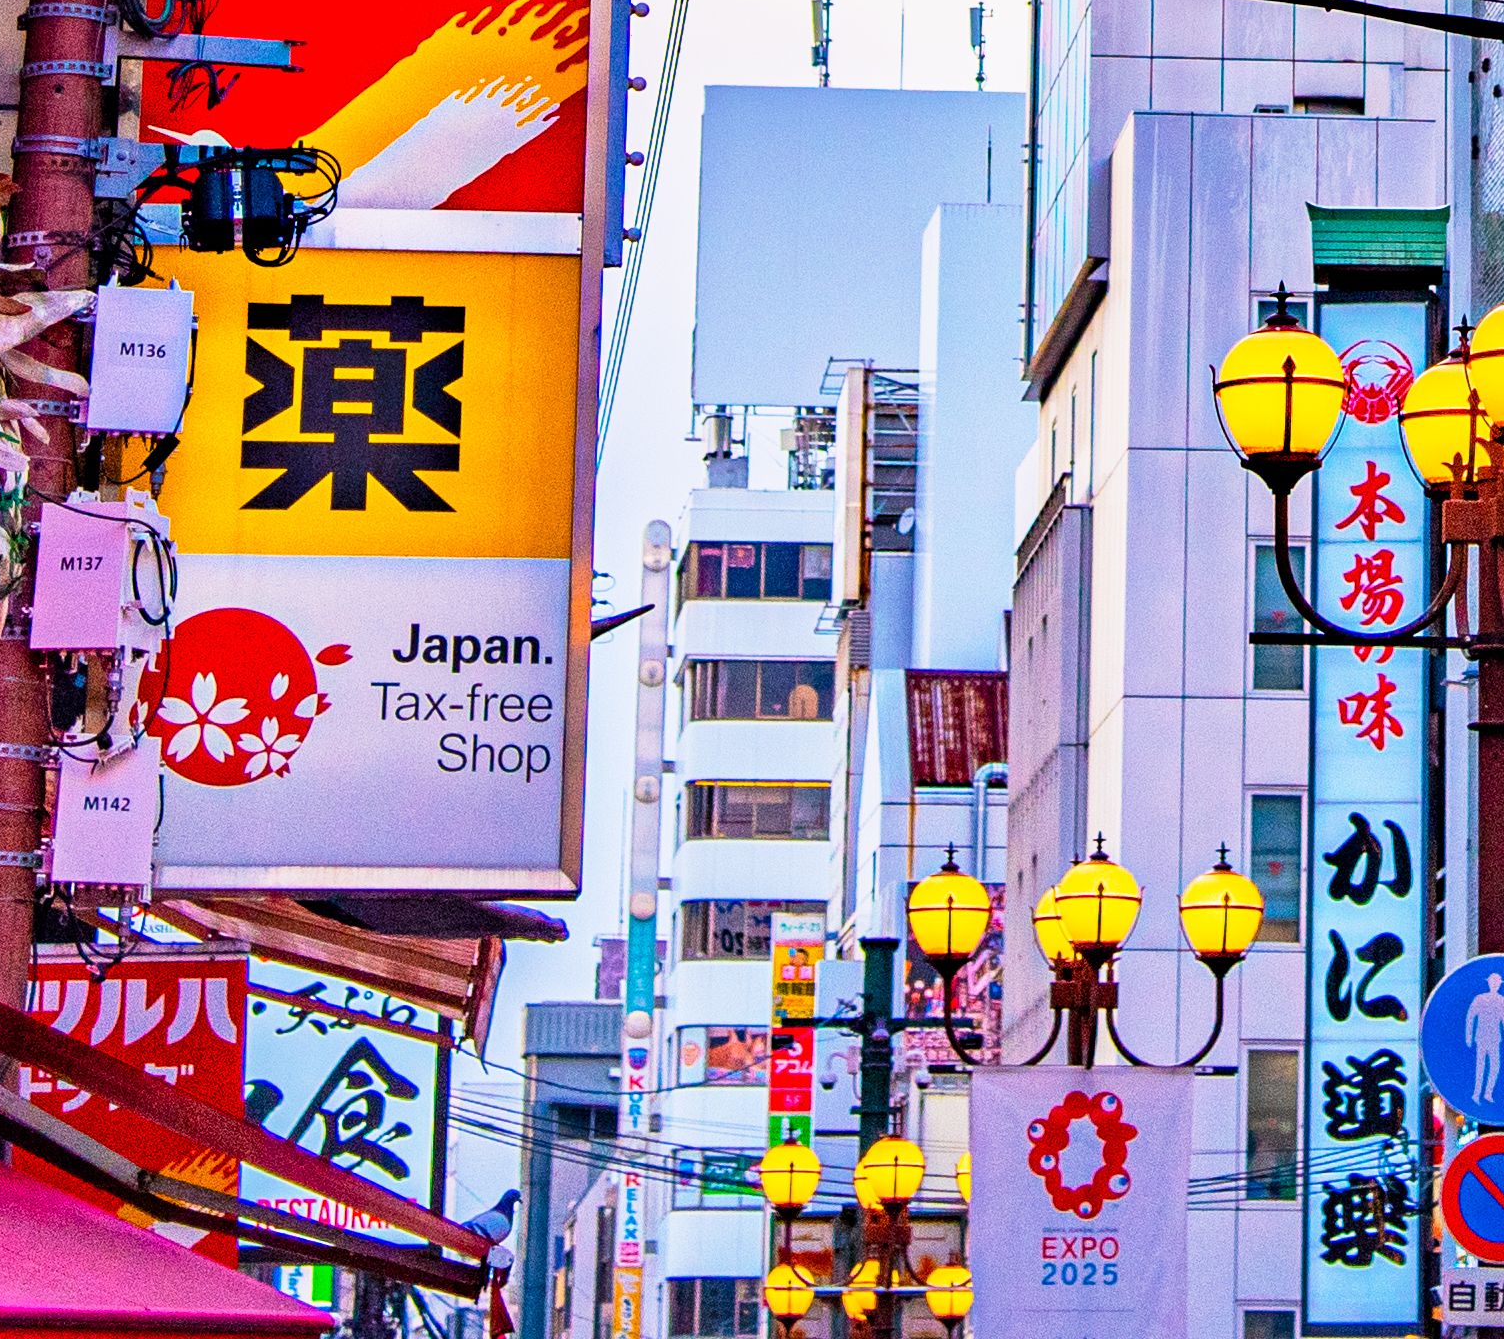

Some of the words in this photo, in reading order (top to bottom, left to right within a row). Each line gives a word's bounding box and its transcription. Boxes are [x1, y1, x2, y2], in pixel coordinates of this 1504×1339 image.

[119, 341, 166, 360] M136
[240, 294, 466, 512] 薬
[60, 555, 104, 571] M137
[392, 624, 553, 673] Japan.
[371, 682, 553, 723] Tax-free
[437, 733, 551, 782] Shop
[83, 796, 130, 812] M142
[1042, 1237, 1119, 1259] EXPO
[1042, 1263, 1118, 1285] 2025
